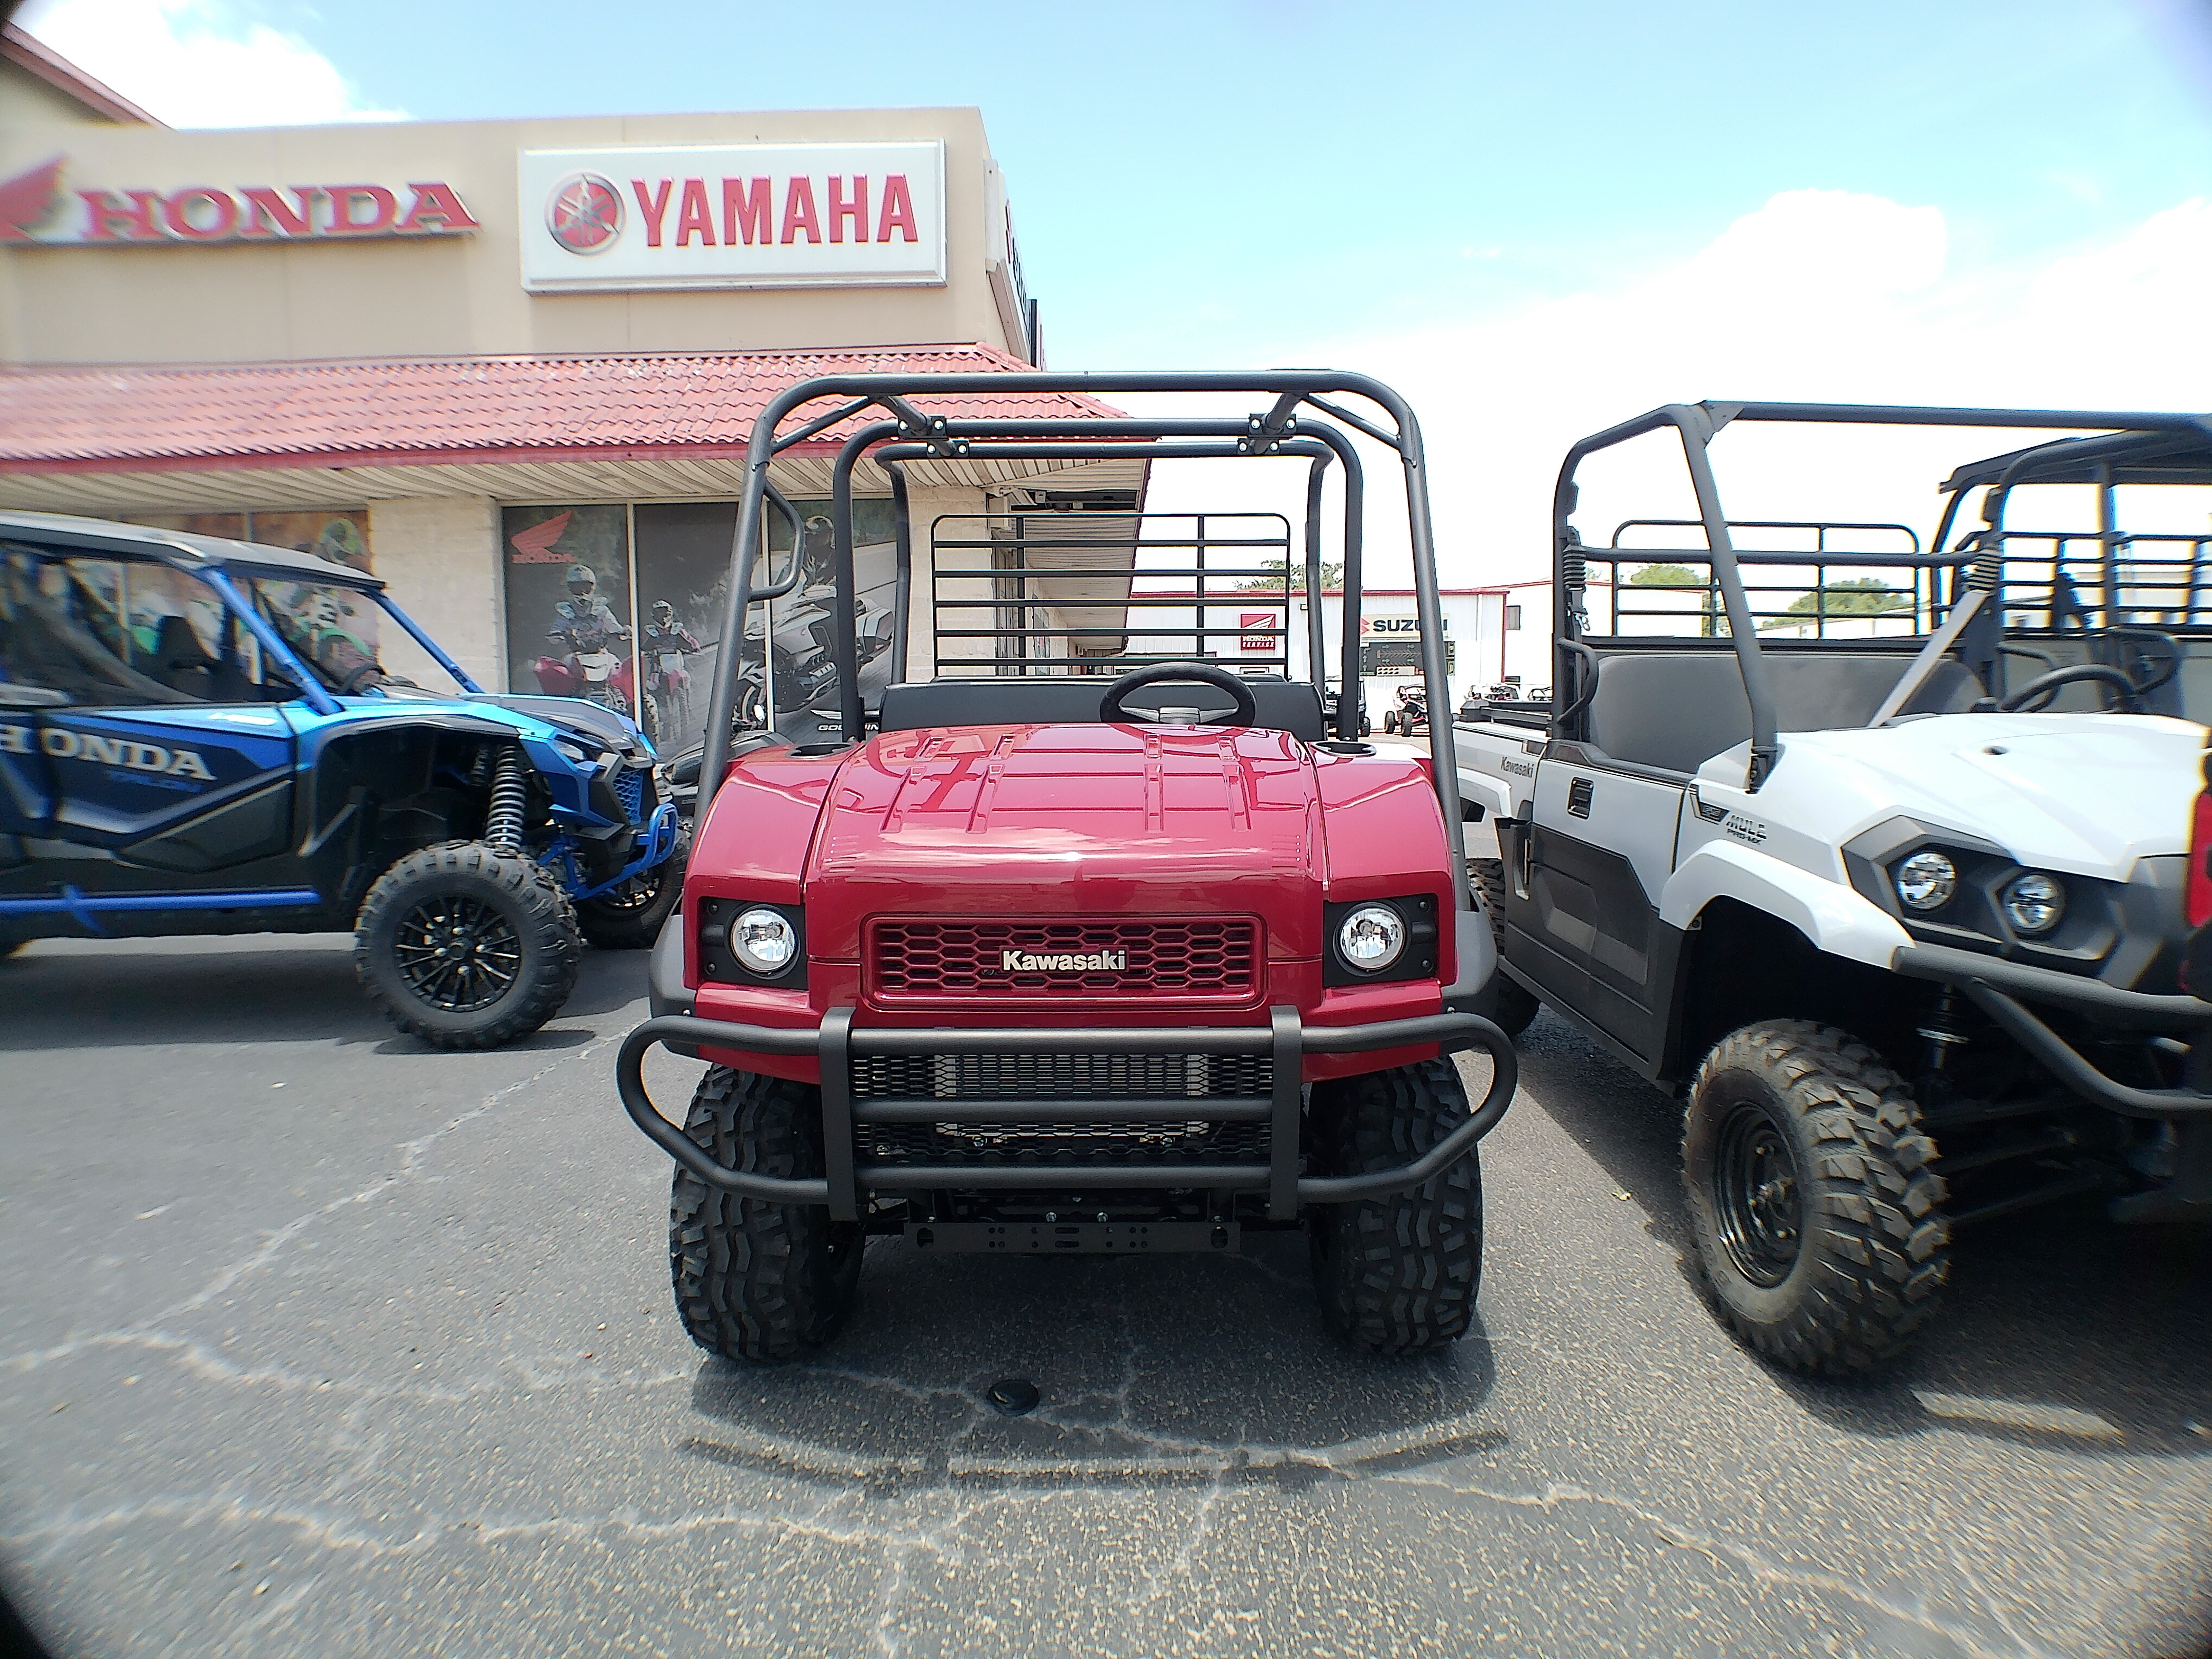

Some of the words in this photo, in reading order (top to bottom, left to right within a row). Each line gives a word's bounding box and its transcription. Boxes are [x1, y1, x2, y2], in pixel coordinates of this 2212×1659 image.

[77, 181, 480, 240] HONDA
[631, 173, 919, 248] YAMAHA
[513, 554, 576, 563] HONDA
[1373, 619, 1448, 632] SUZI
[1501, 756, 1535, 778] Kawasaki
[1726, 815, 1767, 840] MULE
[1003, 950, 1125, 971] Kawasaki
